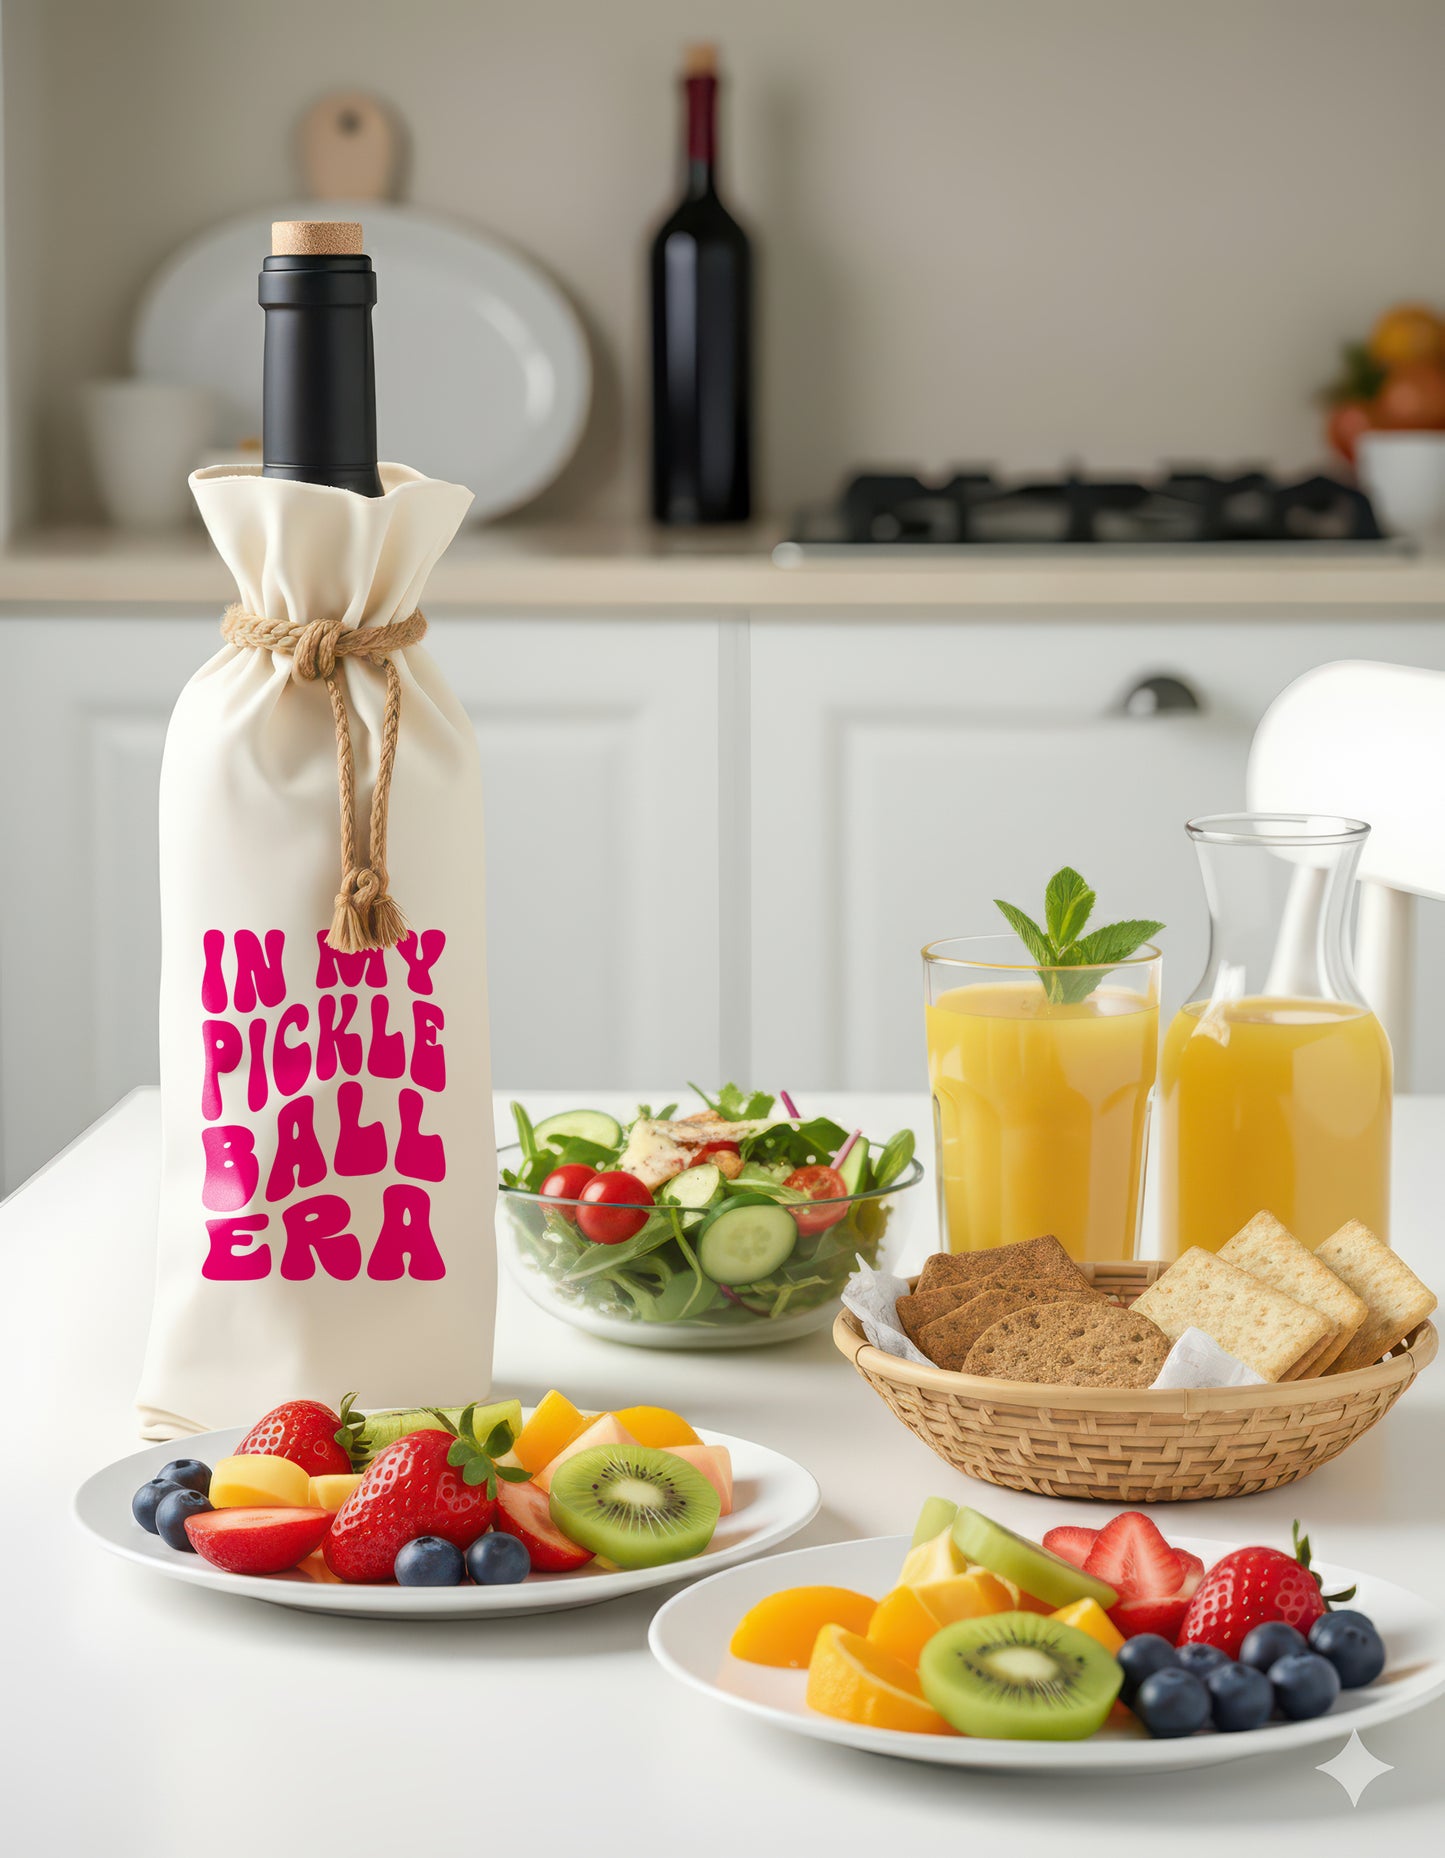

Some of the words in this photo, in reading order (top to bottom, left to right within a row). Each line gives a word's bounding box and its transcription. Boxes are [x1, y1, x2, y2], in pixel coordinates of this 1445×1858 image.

[202, 929, 287, 1014] IN
[316, 929, 447, 996] MY
[202, 994, 447, 1121] PICKLE
[202, 1081, 447, 1212] BALL
[202, 1184, 447, 1281] ERA
